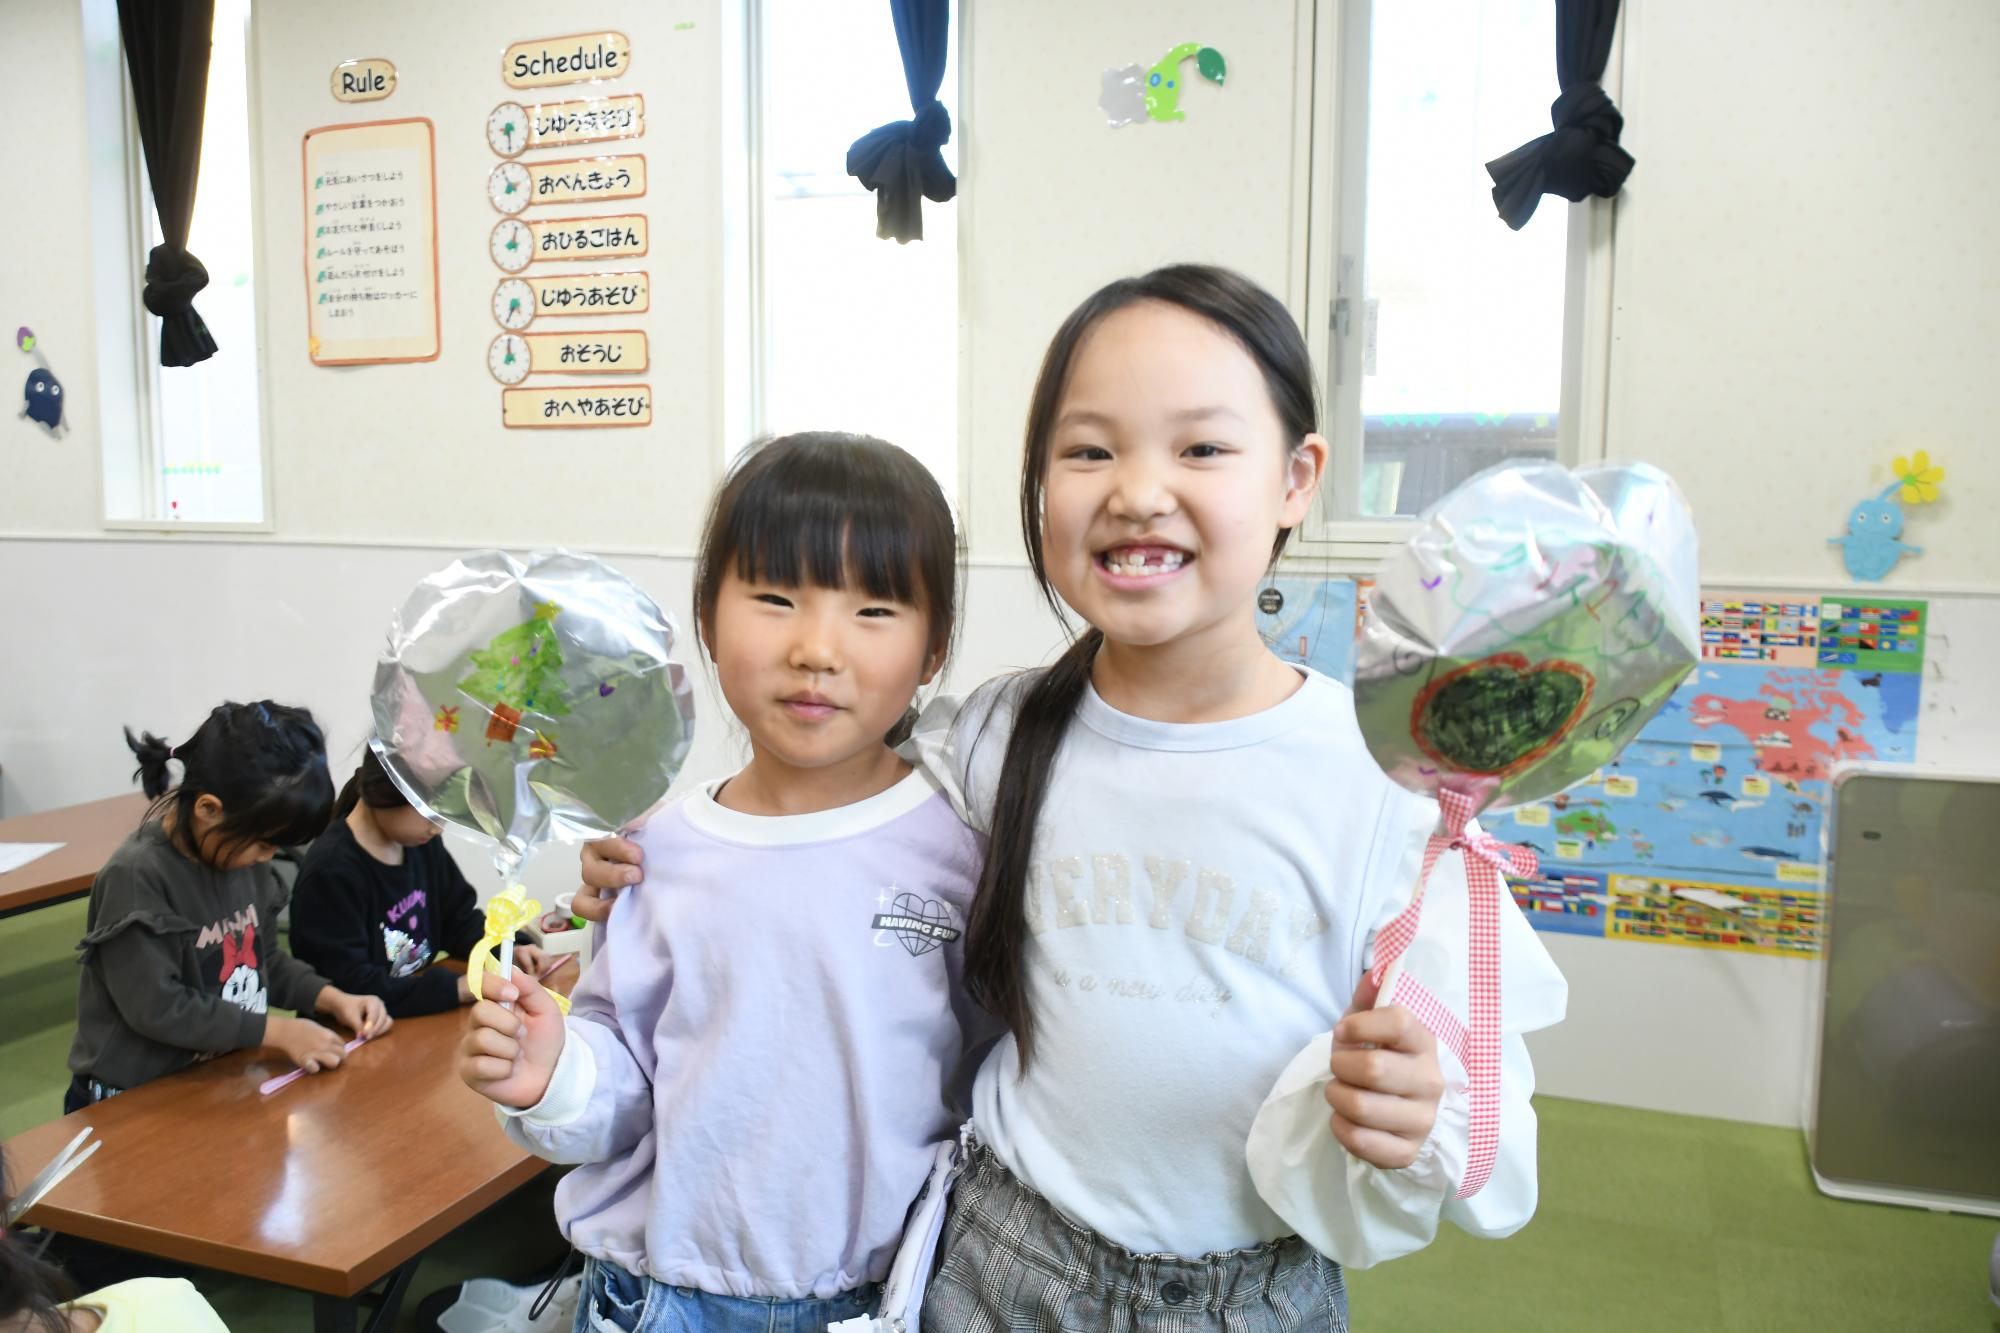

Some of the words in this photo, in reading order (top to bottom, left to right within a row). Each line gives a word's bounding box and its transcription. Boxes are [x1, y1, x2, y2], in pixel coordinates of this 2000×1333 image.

[513, 43, 618, 78] Schedule
[342, 68, 386, 94] Rule
[539, 169, 630, 195] おべんきょう
[541, 227, 639, 251] おひるごはん
[541, 284, 638, 307] じゆうあそび
[560, 344, 623, 363] おそうじ
[544, 396, 645, 418] おへやあそび
[880, 916, 932, 934] HAVING
